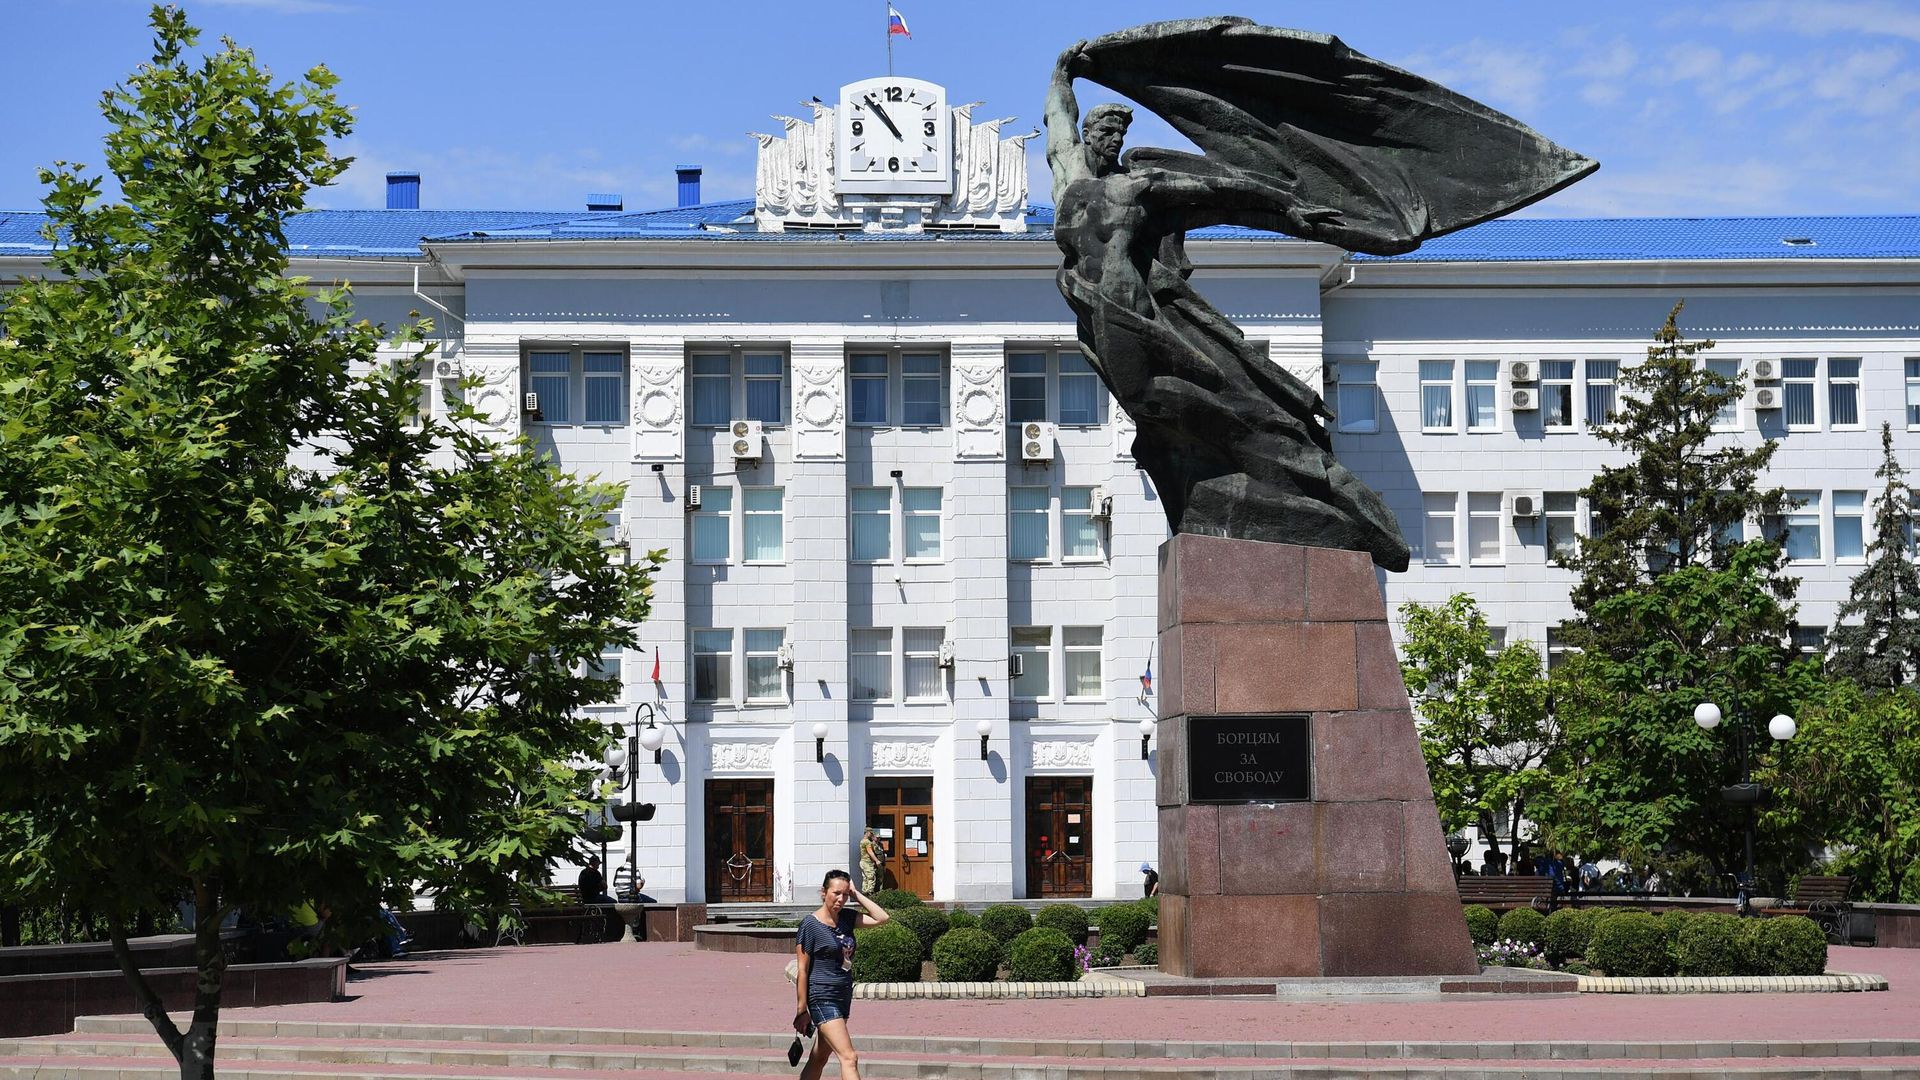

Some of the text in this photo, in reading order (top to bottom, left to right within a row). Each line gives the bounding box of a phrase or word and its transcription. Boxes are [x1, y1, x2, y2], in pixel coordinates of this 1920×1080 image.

[884, 86, 902, 102] 12
[852, 121, 863, 136] 9
[924, 121, 935, 137] 3
[888, 156, 900, 173] 6
[1217, 732, 1281, 746] БОРЦЯМ
[1239, 753, 1258, 765] ЗА
[1214, 771, 1284, 784] СВОБОДУ
